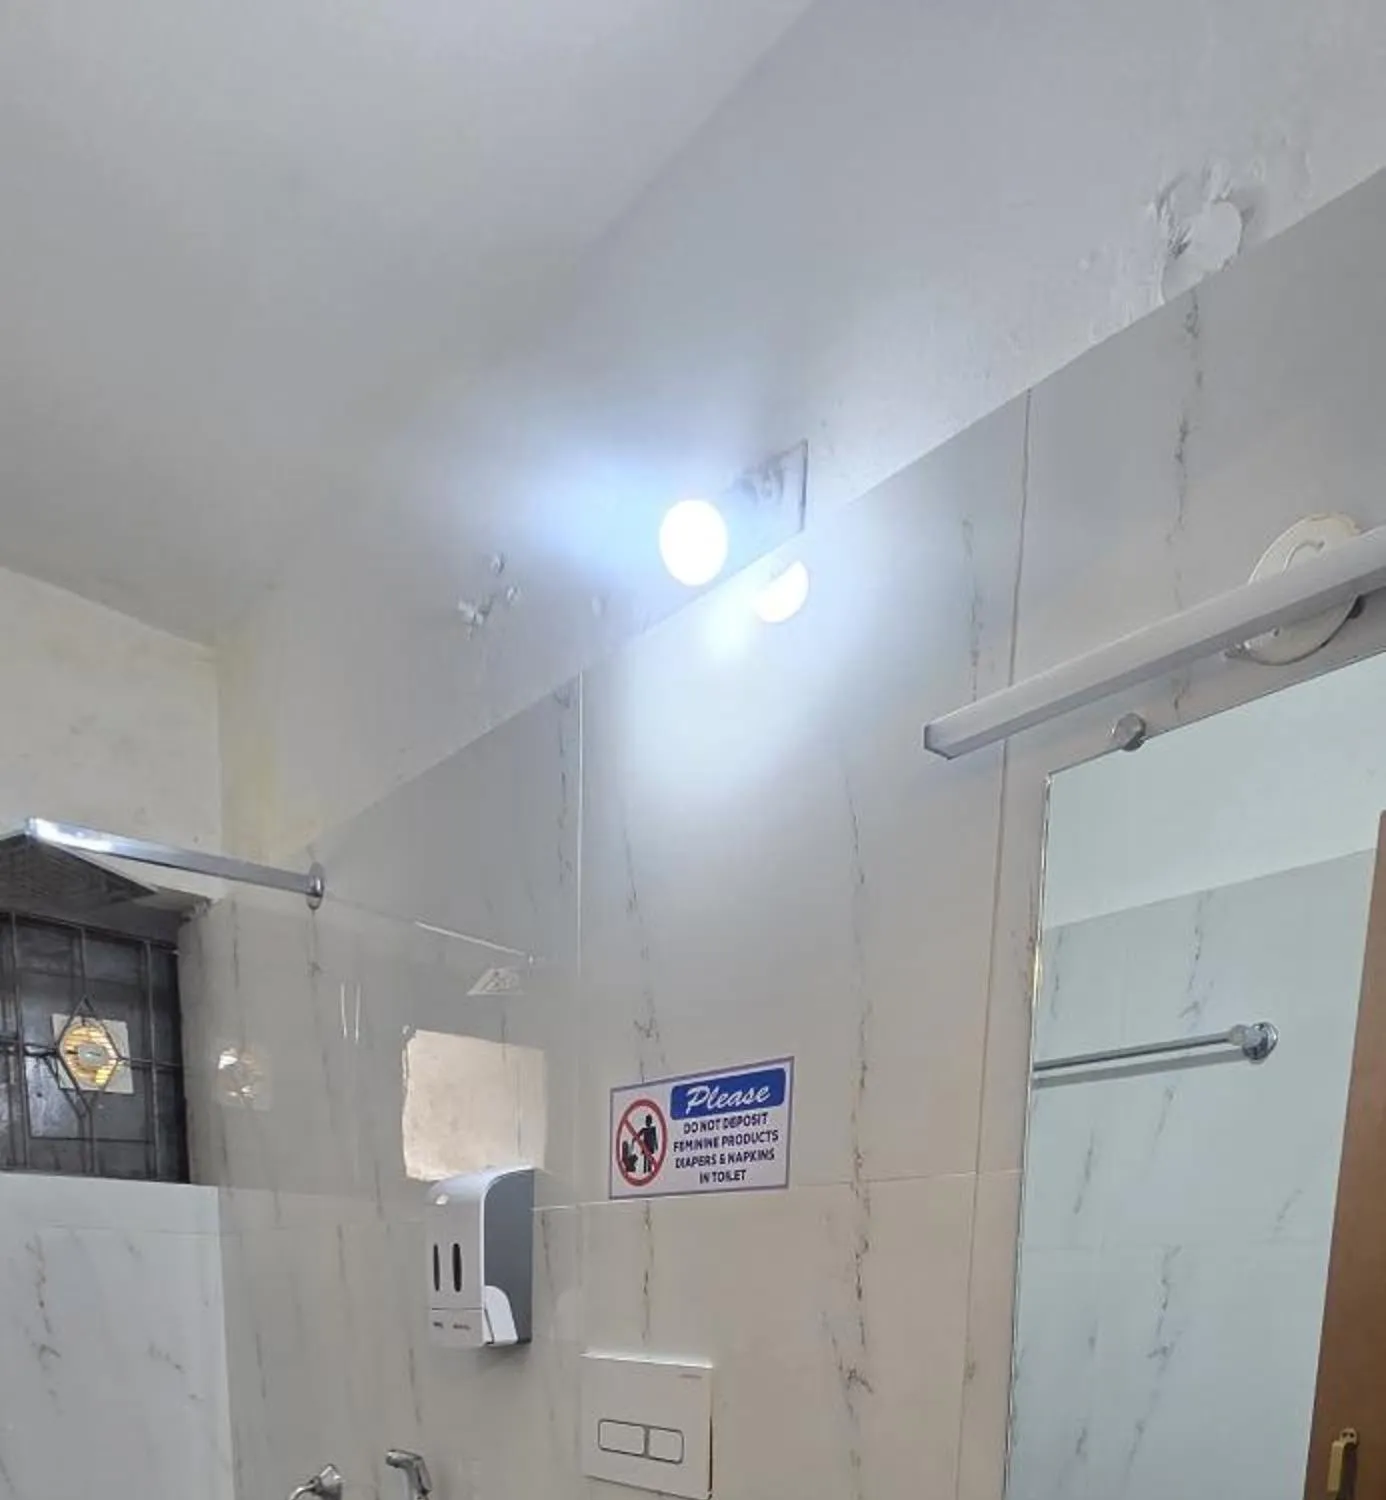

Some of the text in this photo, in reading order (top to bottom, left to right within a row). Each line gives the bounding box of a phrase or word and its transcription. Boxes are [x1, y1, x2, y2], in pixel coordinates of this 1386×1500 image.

[685, 1085, 771, 1114] Please
[684, 1113, 768, 1135] DO NOT DEPOSIT
[673, 1130, 779, 1153] FEMININE PRODUCTS
[675, 1148, 775, 1169] DIAPERS & NAPKINS
[700, 1170, 746, 1184] IN TOILET
